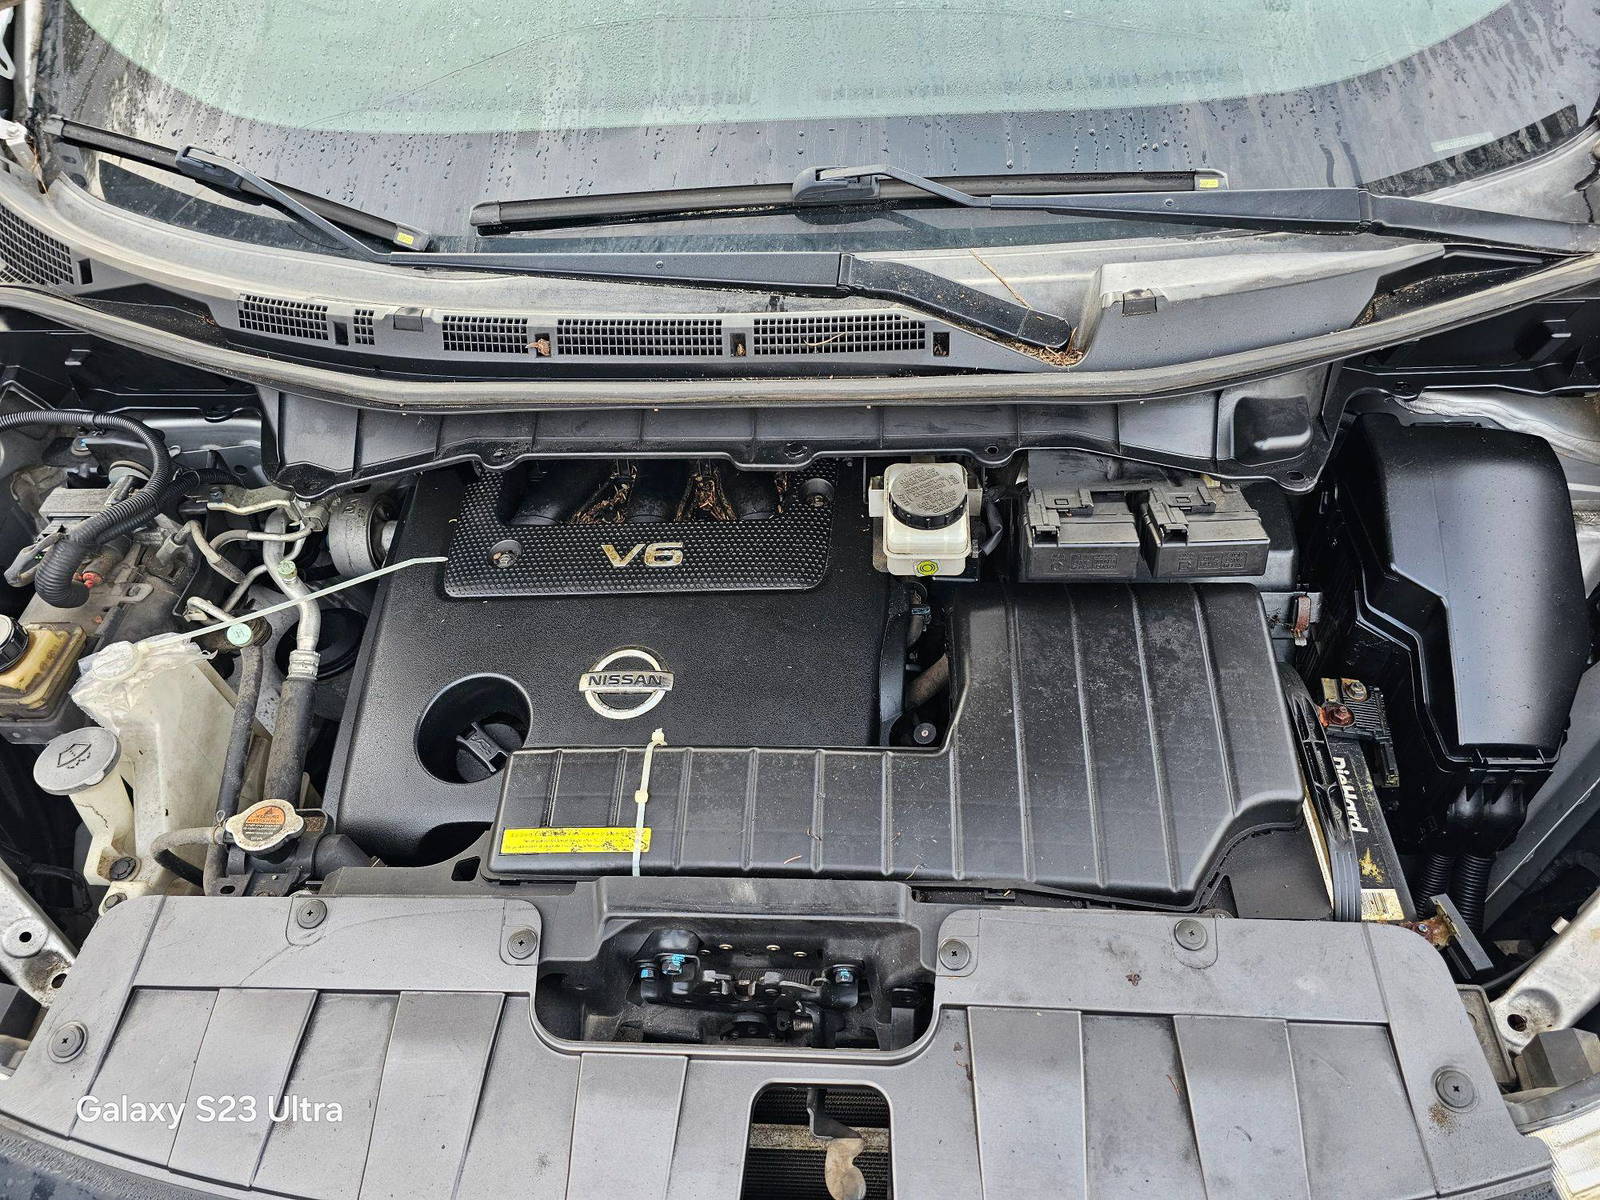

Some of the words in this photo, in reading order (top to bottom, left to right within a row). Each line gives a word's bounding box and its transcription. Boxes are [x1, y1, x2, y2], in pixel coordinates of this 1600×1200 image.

[600, 541, 684, 567] V6
[588, 674, 663, 686] NISSAN
[1333, 756, 1369, 833] DieHard
